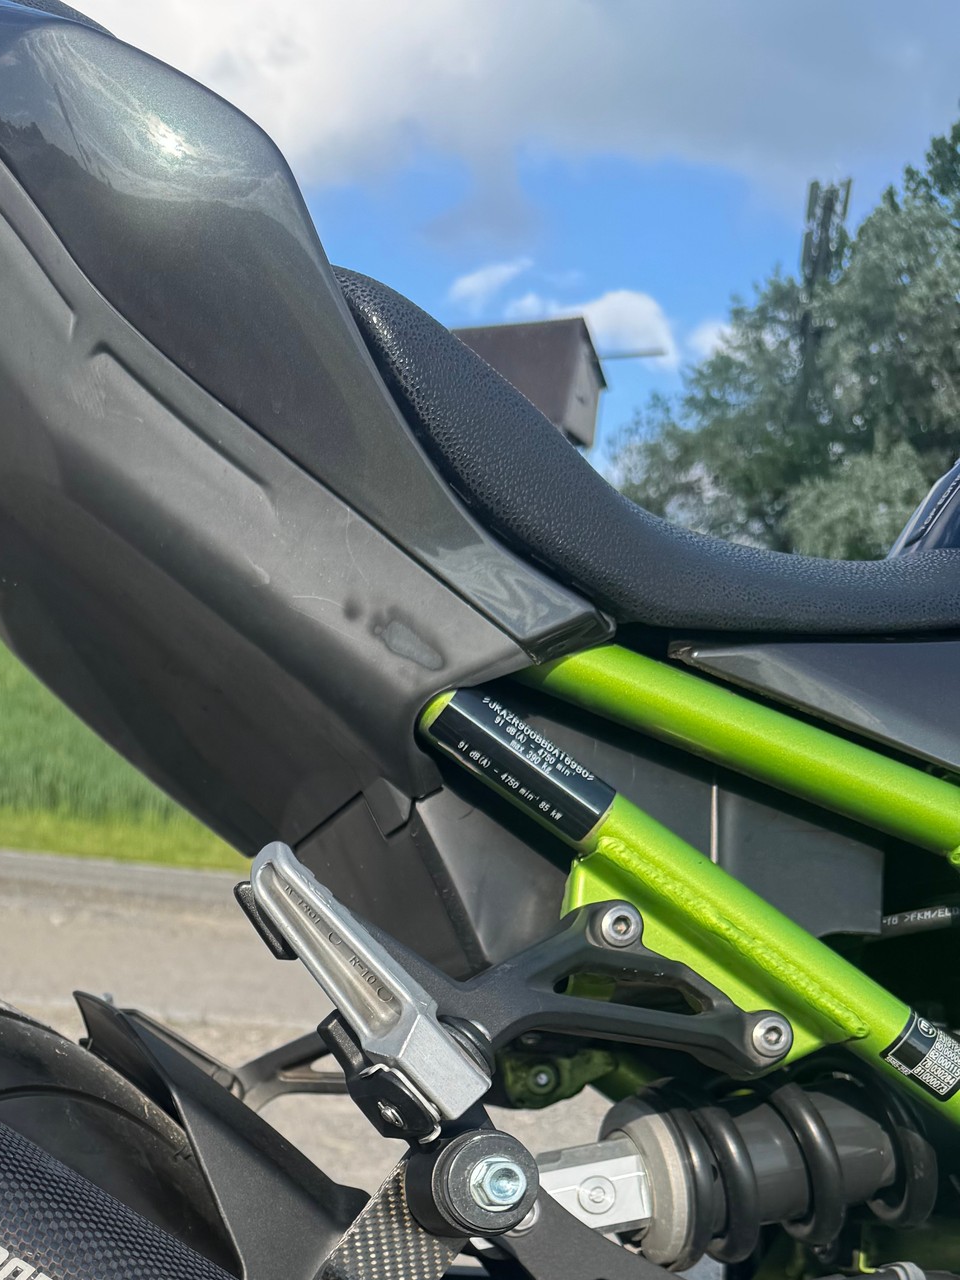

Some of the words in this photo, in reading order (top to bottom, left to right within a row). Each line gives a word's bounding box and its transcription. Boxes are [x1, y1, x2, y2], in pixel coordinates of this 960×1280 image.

[494, 716, 503, 726] 91
[506, 724, 527, 744] dB(A)
[537, 748, 555, 764] 4750
[510, 740, 524, 753] max
[526, 751, 541, 765] 390
[540, 762, 554, 775] kg
[457, 740, 468, 751] 91
[469, 749, 491, 768] dB(A)
[500, 772, 518, 789] 4750
[538, 801, 550, 812] 85
[550, 809, 562, 821] kW
[929, 1050, 938, 1060] 62
[913, 1066, 923, 1076] 81
[922, 1072, 948, 1093] 000073
[922, 1059, 932, 1068] 78
[930, 1065, 956, 1085] 030284
